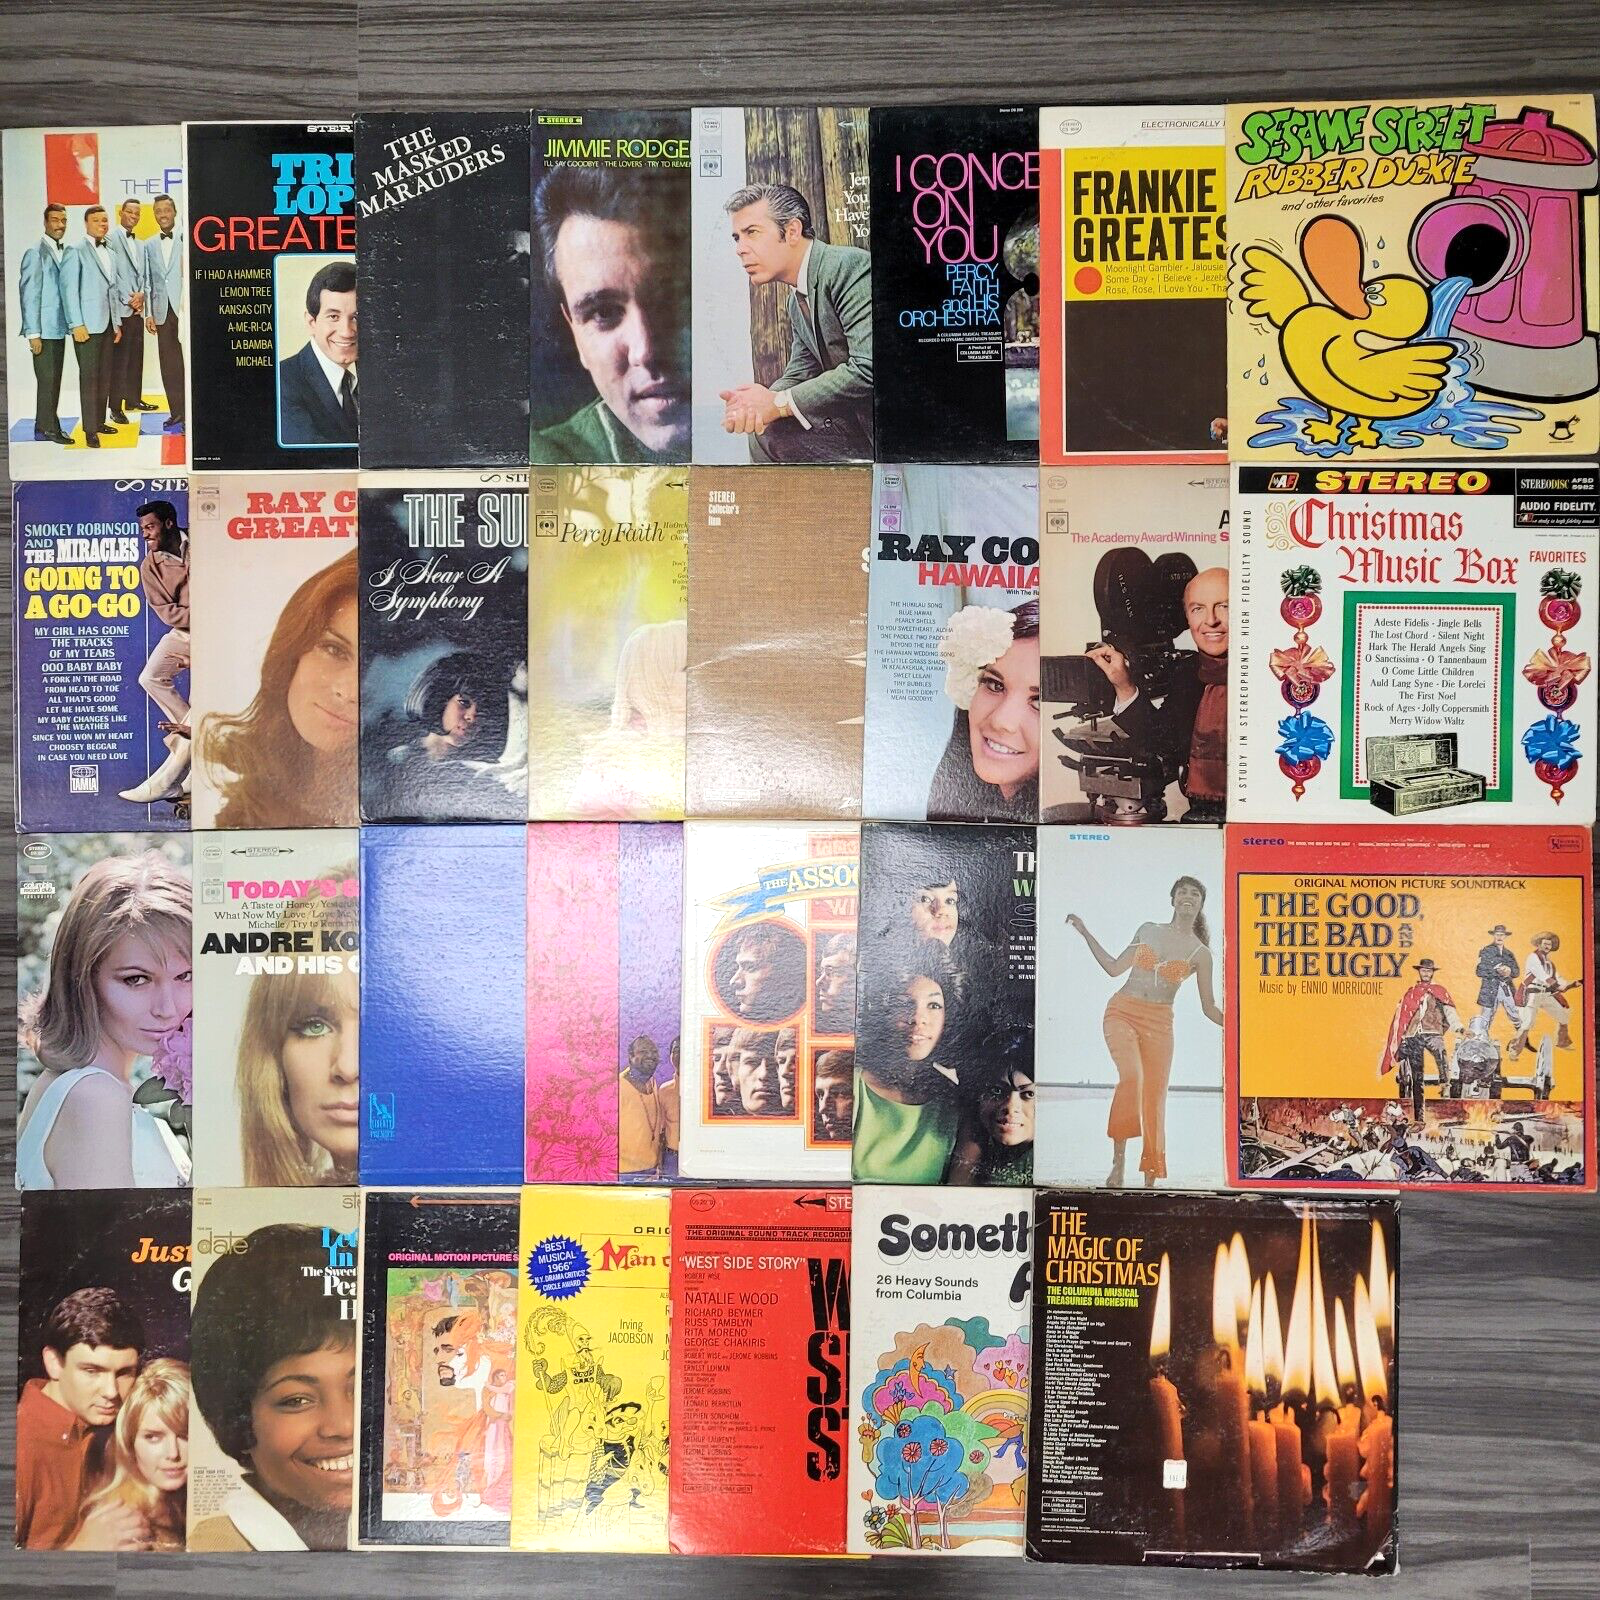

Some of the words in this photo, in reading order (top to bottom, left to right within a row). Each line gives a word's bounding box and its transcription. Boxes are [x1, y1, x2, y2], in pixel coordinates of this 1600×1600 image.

[1141, 120, 1219, 128] ELECTRONICALLY
[1236, 105, 1371, 164] SESAME
[1372, 103, 1496, 155] STREET
[383, 126, 436, 161] THE
[543, 139, 611, 159] JIMMIE
[617, 139, 690, 159] RODGE
[272, 153, 353, 185] TRI
[372, 135, 472, 190] MASKED
[357, 143, 506, 218] MARAUDERS
[895, 154, 901, 192] I
[1235, 156, 1369, 203] RUBBER
[1368, 154, 1480, 188] DUCKIE
[120, 179, 161, 194] THE
[1073, 169, 1217, 215] FRANKIE
[273, 185, 354, 215] LOP
[913, 189, 974, 228] ON
[1281, 200, 1302, 211] and
[1306, 198, 1335, 210] other
[1337, 194, 1384, 207] favorites
[194, 216, 354, 251] GREATE
[913, 225, 998, 264] YOU
[946, 264, 999, 280] PERCY
[1105, 263, 1145, 273] Moonlight
[1148, 263, 1183, 272] Gambler
[1191, 262, 1224, 271] Jalousie
[952, 279, 999, 295] FAITH
[219, 304, 252, 316] KANSAS
[254, 304, 272, 315] CITY
[942, 293, 970, 311] and
[973, 294, 999, 311] HIS
[228, 321, 272, 333] A-ME-RI-CA
[899, 310, 1001, 327] ORCHESTRA
[236, 356, 273, 367] MICHAEL
[1315, 471, 1491, 493] STEREO
[247, 491, 326, 514] RAY
[709, 491, 735, 503] STEREO
[1520, 501, 1550, 511] AUDIO
[708, 503, 739, 515] Collector's
[24, 524, 73, 537] SMOKEY
[77, 522, 139, 536] ROBINSON
[227, 516, 358, 540] GREAT
[403, 493, 465, 547] THE
[1243, 509, 1252, 544] SOUND
[1289, 497, 1464, 549] Christmas
[560, 522, 616, 547] Percy
[613, 521, 665, 543] Faith
[1071, 533, 1089, 543] The
[1091, 533, 1139, 544] Academy
[1141, 532, 1217, 544] Award-Winning
[24, 538, 53, 548] AND
[56, 538, 139, 563] MIRACLES
[24, 550, 54, 563] THE
[878, 533, 976, 564] RAY
[1529, 551, 1586, 563] FAVORITES
[402, 554, 465, 584] Hear
[466, 556, 512, 586] A
[1336, 546, 1442, 584] Music
[1453, 548, 1519, 584] Box
[24, 566, 102, 591] GOING
[106, 566, 140, 590] TO
[1242, 553, 1251, 601] FIDELITY
[24, 595, 48, 619] A
[49, 593, 141, 618] GO-GO
[369, 587, 484, 621] Symphony
[35, 627, 48, 636] MY
[52, 627, 74, 636] GIRL
[78, 626, 99, 635] HAS
[102, 625, 129, 635] GONE
[1374, 618, 1400, 627] Adeste
[1404, 618, 1429, 627] Fidelis
[1436, 619, 1460, 629] Jingle
[1463, 619, 1482, 628] Bells
[1369, 643, 1388, 651] Hark
[1392, 643, 1407, 651] The
[1410, 643, 1436, 652] Herald
[1440, 644, 1465, 653] Angels
[1469, 644, 1486, 653] Sing
[67, 662, 93, 672] BABY
[96, 662, 122, 671] BABY
[1240, 644, 1248, 727] STEREOPHONIC
[1364, 703, 1384, 712] Rock
[1386, 703, 1394, 711] of
[1396, 703, 1416, 713] Ages
[1422, 704, 1439, 713] Jolly
[1441, 704, 1489, 714] Coppersmith
[1239, 734, 1247, 749] IN
[1239, 755, 1247, 791] STUDY
[1242, 837, 1285, 846] stereo
[227, 880, 336, 900] TODAY'S
[764, 878, 788, 889] THE
[1294, 878, 1346, 889] ORIGINAL
[1350, 878, 1397, 889] MOTION
[1401, 879, 1446, 890] PICTURE
[1450, 879, 1526, 890] SOUNDTRACK
[214, 911, 240, 921] What
[243, 911, 263, 920] Now
[266, 911, 281, 921] My
[283, 911, 306, 920] Love
[1254, 892, 1320, 918] THE
[1326, 893, 1425, 921] GOOD,
[200, 932, 316, 954] ANDRE
[1254, 922, 1320, 947] THE
[1324, 922, 1393, 947] BAD
[235, 956, 294, 975] AND
[297, 956, 344, 975] HIS
[1254, 951, 1320, 977] THE
[1325, 952, 1411, 978] UGLY
[1259, 980, 1284, 994] Music
[1287, 981, 1297, 997] by
[1301, 981, 1328, 995] ENNIO
[1332, 981, 1383, 996] MORRICONE
[1049, 1212, 1087, 1235] THE
[197, 1231, 249, 1256] date
[1048, 1236, 1110, 1261] MAGIC
[1115, 1238, 1144, 1262] OF
[388, 1253, 433, 1262] ORIGINAL
[434, 1253, 470, 1262] MOTION
[471, 1253, 511, 1262] PICTURE
[538, 1251, 576, 1264] MUSICAL
[593, 1237, 657, 1271] Man
[723, 1256, 754, 1269] SIDE
[876, 1275, 891, 1286] 26
[895, 1276, 931, 1288] Heavy
[934, 1276, 978, 1288] Sounds
[1046, 1260, 1160, 1286] CHRISTMAS
[685, 1293, 737, 1305] NATALIE
[740, 1293, 779, 1305] WOOD
[876, 1289, 903, 1299] from
[906, 1289, 962, 1300] Columbia
[1047, 1286, 1061, 1296] THE
[1062, 1286, 1102, 1297] COLUMBIA
[1104, 1287, 1139, 1298] MUSICAL
[1047, 1295, 1093, 1306] TREASURIES
[1094, 1297, 1139, 1308] ORCHESTRA
[619, 1318, 643, 1332] Irving
[608, 1332, 653, 1344] JACOBSON
